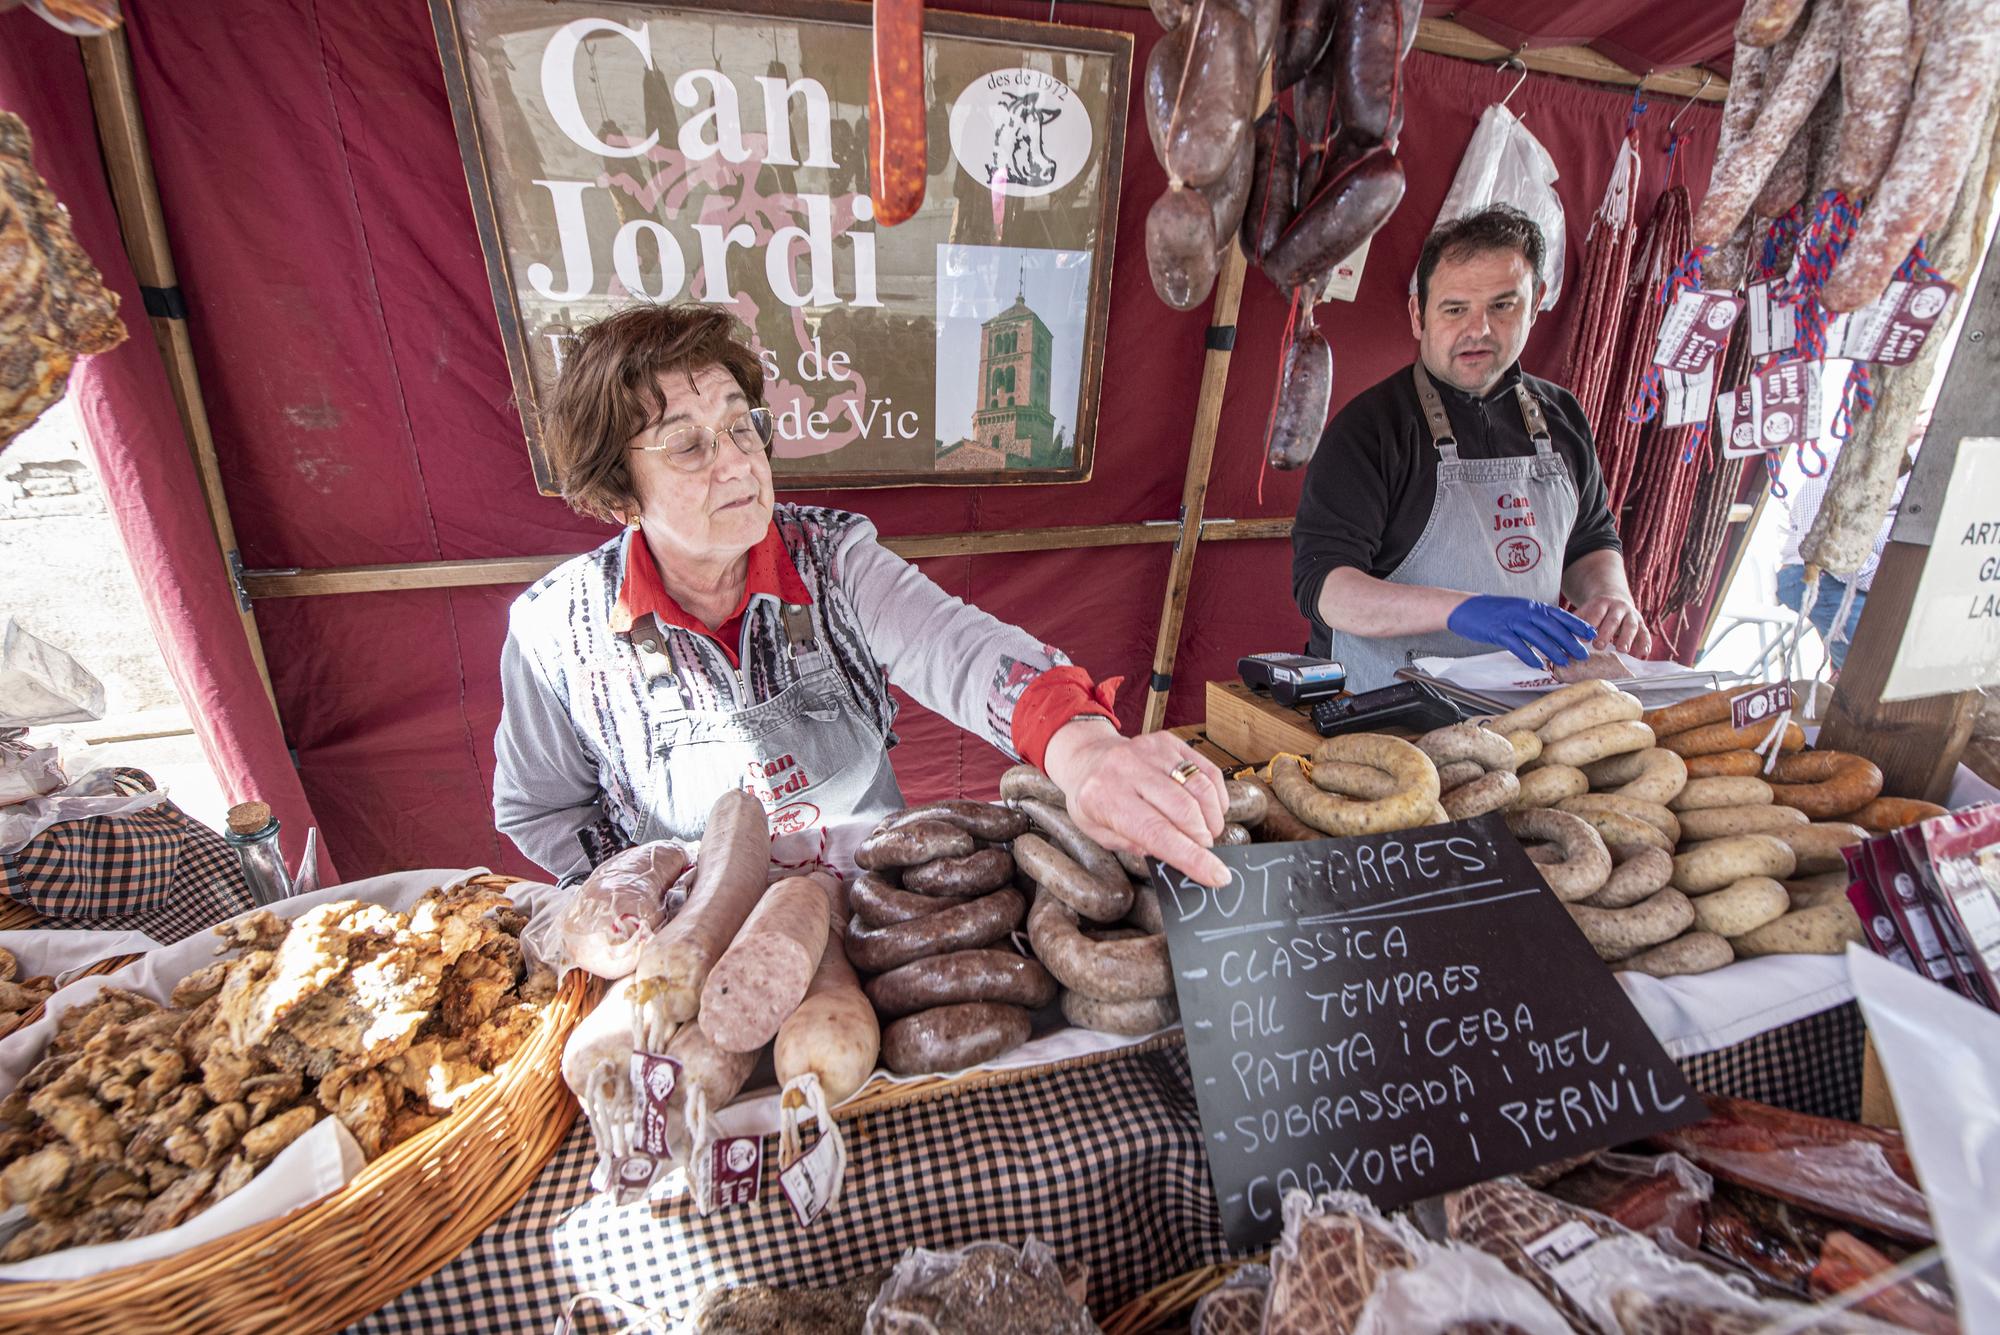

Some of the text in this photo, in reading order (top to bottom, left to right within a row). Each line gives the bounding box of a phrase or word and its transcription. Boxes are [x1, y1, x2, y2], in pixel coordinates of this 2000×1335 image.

[540, 17, 841, 169] Can
[987, 70, 1068, 101] des de 1972
[527, 179, 885, 308] Jordi
[797, 336, 851, 382] de
[778, 398, 919, 440] de Vic
[1494, 512, 1536, 531] Jordi
[1497, 494, 1530, 510] Can
[1960, 522, 2000, 545] ART
[748, 754, 795, 779] Can
[1232, 1032, 1376, 1101] PATATA
[1426, 1002, 1534, 1057] CEBA
[1234, 1065, 1475, 1153] SOBRASSADA
